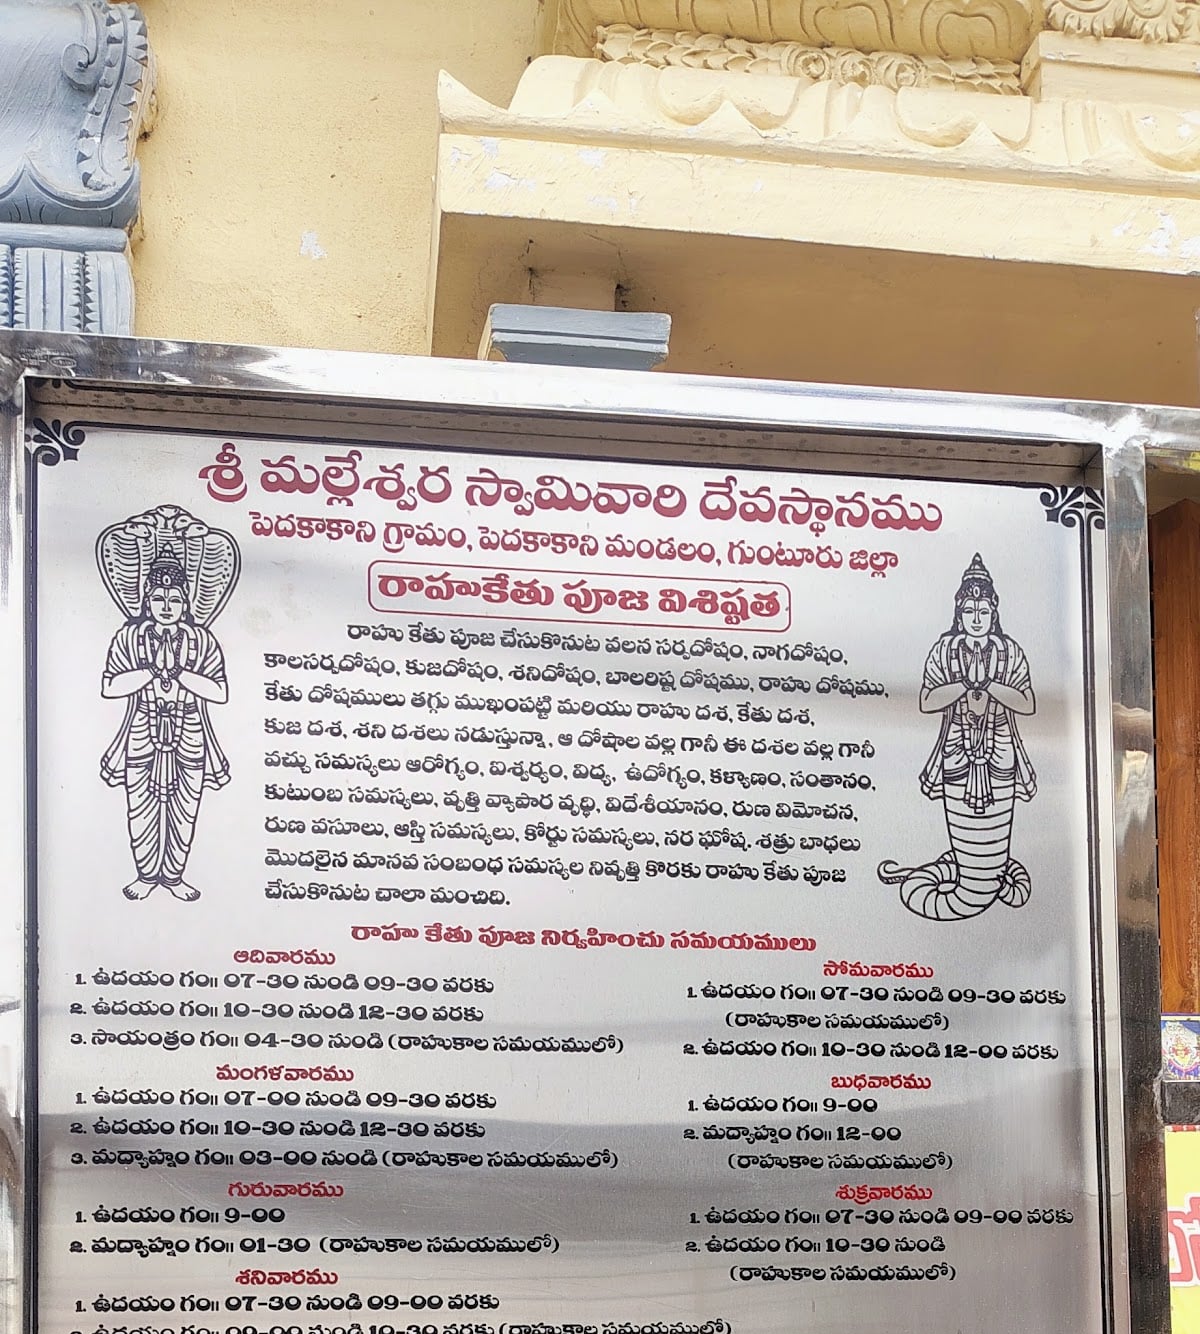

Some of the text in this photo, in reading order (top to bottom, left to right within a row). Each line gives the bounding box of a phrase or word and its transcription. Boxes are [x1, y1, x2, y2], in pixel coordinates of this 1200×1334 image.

[197, 442, 943, 538] శ్రీ మల్లేశ్వర స్వామివారి దేవస్థానము
[248, 510, 377, 544] పెదకాకాని
[477, 525, 600, 557] పెదకాకాని
[726, 539, 844, 570] గుంటూరు
[848, 549, 899, 579] జిల్లా
[561, 578, 650, 615] పూజ
[657, 587, 781, 626] విశిష్టత
[346, 623, 405, 643] రాహు
[407, 621, 446, 645] కేతు
[449, 627, 496, 651] పూజ
[499, 627, 601, 653] చేసుకొనుట
[604, 636, 652, 655] వలన
[758, 675, 812, 694] రాహు
[263, 679, 303, 703] కేతు
[307, 682, 407, 709] దోషములు
[556, 697, 633, 718] మరియు
[636, 701, 691, 721] రాహు
[735, 700, 773, 723] కేతు
[263, 750, 312, 775] వచ్చు
[313, 751, 402, 778] సమస్యలు
[263, 782, 344, 803] కుటుంబ
[442, 789, 481, 813] వృత్తి
[484, 792, 554, 814] వ్యాపార
[731, 799, 772, 818] రుణ
[264, 847, 349, 872] మొదలైన
[352, 851, 420, 871] మానవ
[422, 853, 504, 876] సంబంధ
[506, 855, 585, 881] సమస్యల
[644, 859, 702, 879] కొరకు
[704, 862, 760, 881] రాహు
[762, 859, 800, 882] కేతు
[802, 864, 847, 888] పూజ
[264, 877, 511, 906] చేసుకొనుట చాలా మంచిది.
[350, 922, 817, 952] రాహు కేతు పూజ నిర్వహించు సమయములు
[233, 948, 337, 966] ఆదివారము
[822, 959, 934, 979] సోమవారము
[682, 1043, 699, 1056] 2.
[700, 1037, 778, 1057] ఉదయం
[821, 1041, 886, 1058] 10-30
[889, 1041, 941, 1059] నుండి
[944, 1043, 1008, 1060] 12-00
[1011, 1043, 1059, 1060] వరకు
[215, 1063, 355, 1082] మంగళవారము
[830, 1072, 932, 1092] బుధవారము
[227, 1180, 344, 1198] గురువారము
[835, 1183, 933, 1206] శుక్రవారము
[68, 1240, 88, 1254] 2.
[239, 1237, 311, 1253] 01-30
[234, 1267, 339, 1286] శనివారము
